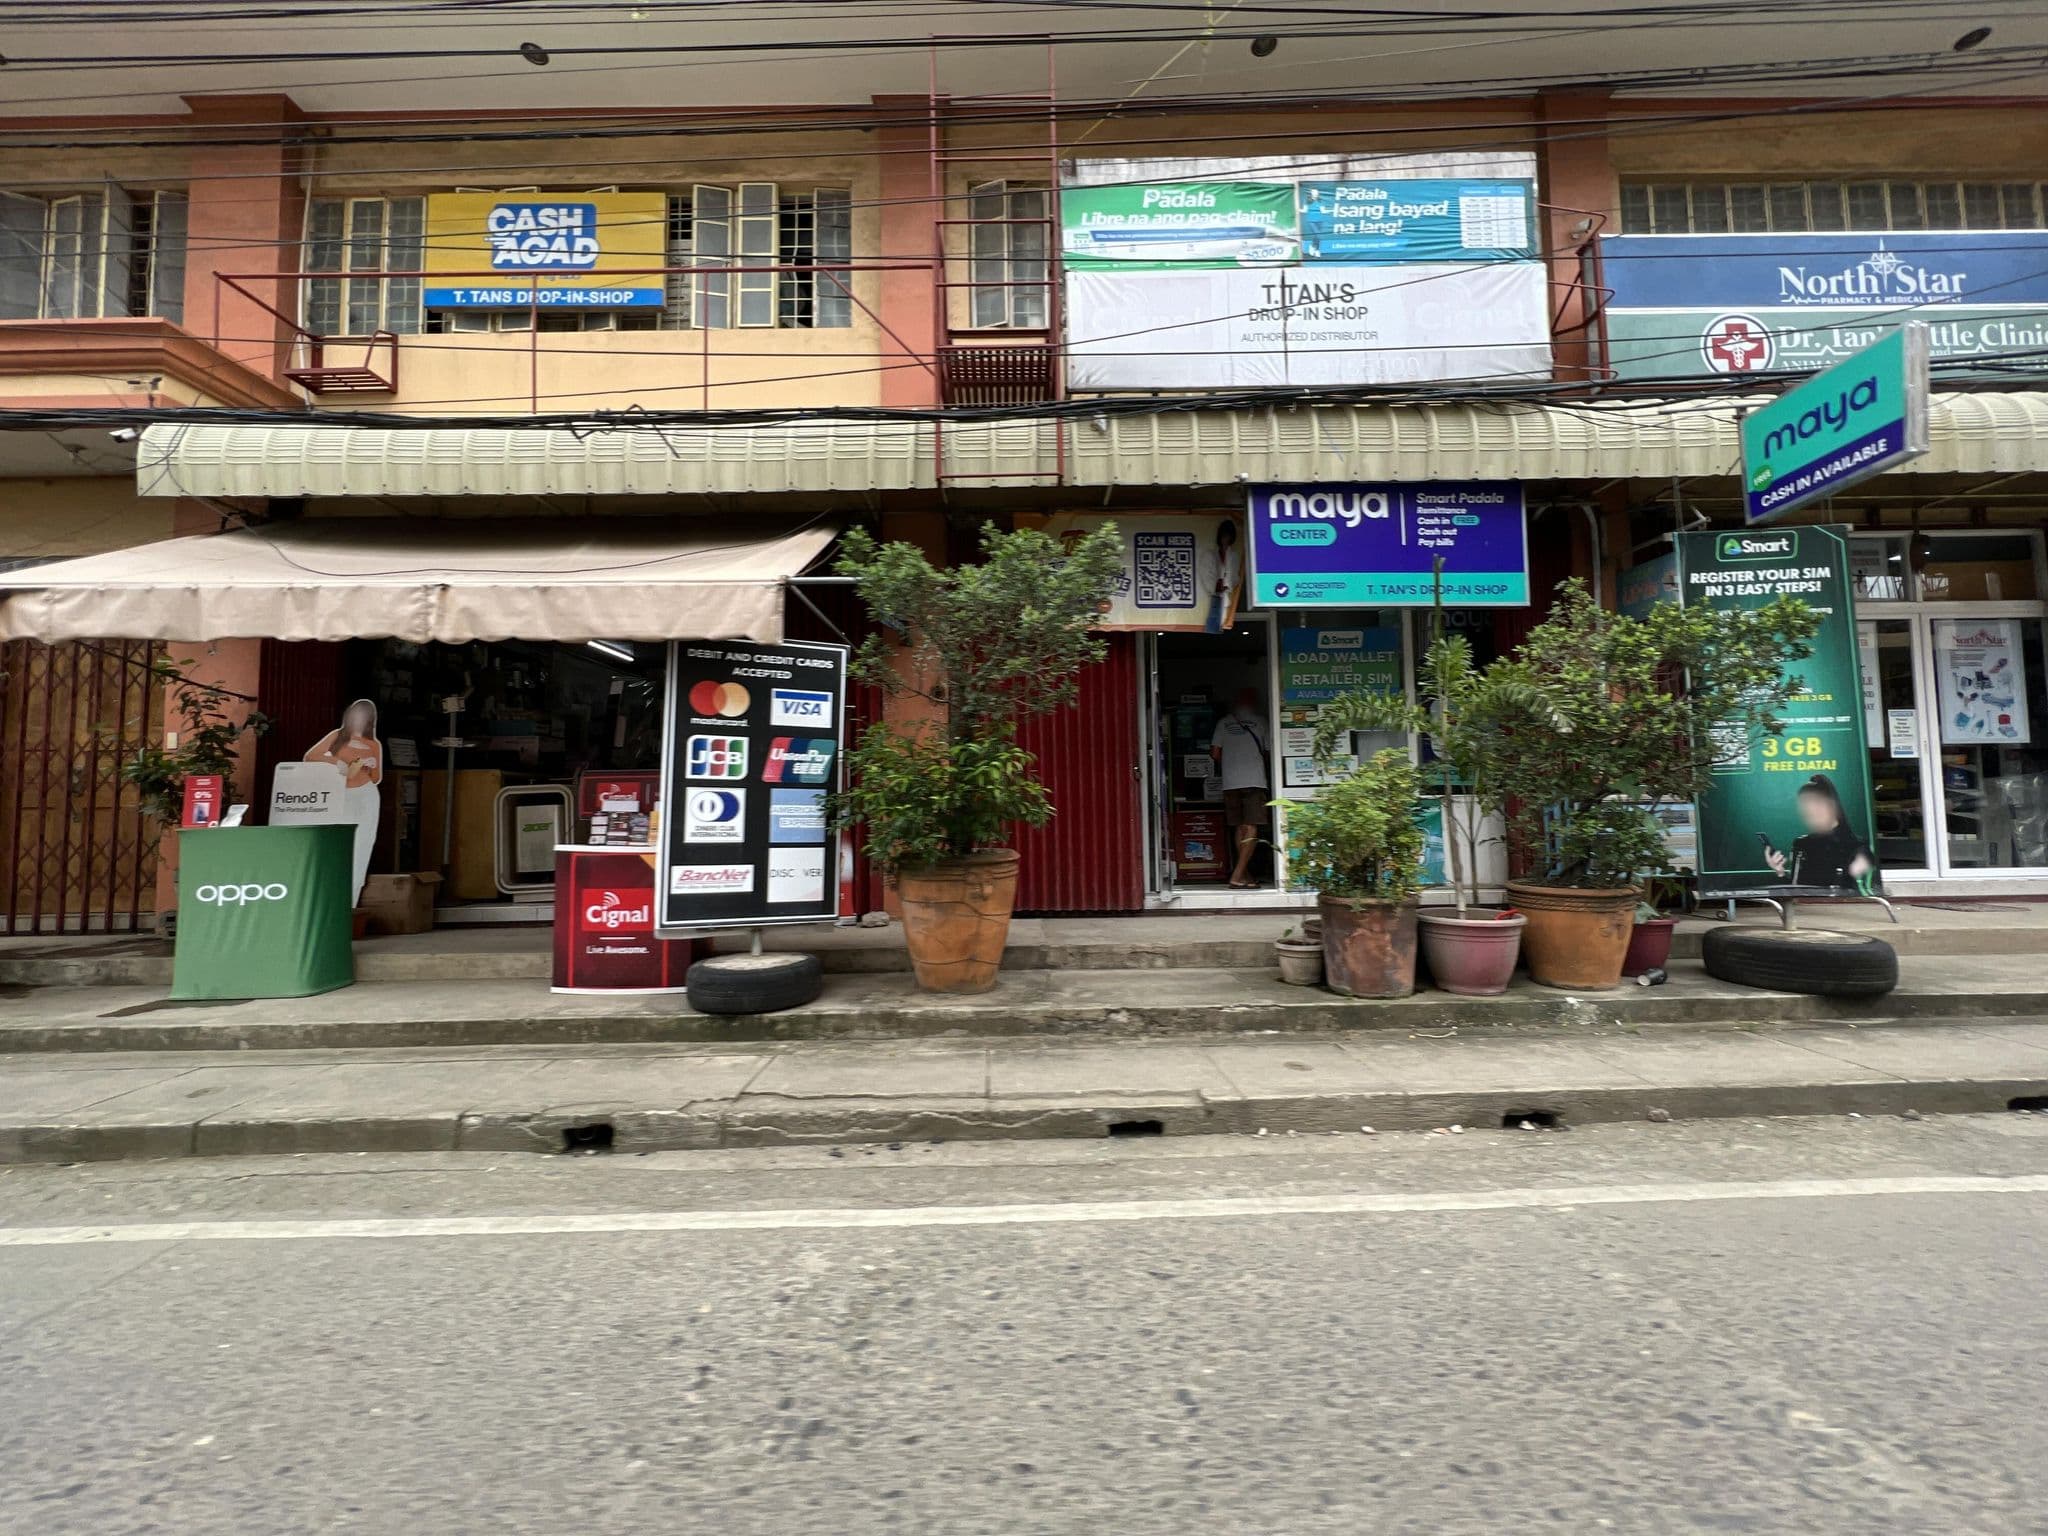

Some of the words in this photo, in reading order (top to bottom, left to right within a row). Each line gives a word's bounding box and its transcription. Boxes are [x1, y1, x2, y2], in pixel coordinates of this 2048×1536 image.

[1143, 188, 1216, 209] Padala
[1335, 187, 1388, 201] Padala
[1333, 202, 1384, 219] Isang
[1389, 200, 1449, 218] bayad
[487, 208, 583, 236] CASH
[1081, 211, 1123, 226] Libre
[1127, 214, 1149, 226] na
[1333, 222, 1355, 234] na
[1359, 219, 1403, 236] lang!
[490, 237, 600, 265] AGAD
[1778, 265, 1881, 297] North
[1895, 265, 1967, 294] Star
[453, 291, 466, 304] T.
[470, 290, 512, 304] TANS
[1249, 307, 1319, 322] DROP-IN
[1324, 306, 1368, 321] SHOP
[1241, 332, 1308, 342] AUTHORIZED
[1311, 331, 1378, 342] DISTRIBUTOR
[1778, 326, 1821, 348] Dr.
[1764, 376, 1877, 459] maya
[1761, 482, 1795, 507] CASH
[1797, 474, 1812, 491] IN
[1812, 438, 1888, 483] AVAILABLE
[1416, 492, 1457, 504] Smart
[1459, 492, 1504, 504] Padala
[1269, 492, 1389, 528] maya
[1416, 506, 1467, 514] Remittance
[1417, 517, 1440, 525] Cash
[1441, 516, 1450, 525] in
[1279, 529, 1328, 540] CENTER
[1417, 528, 1440, 536] Cash
[1441, 528, 1458, 536] out
[1137, 536, 1166, 546] SCAN
[1167, 536, 1193, 546] HERE
[1418, 538, 1435, 548] Pay
[1436, 538, 1455, 546] bills
[1741, 537, 1790, 553] Smart
[1690, 570, 1755, 584] REGISTER
[1756, 568, 1800, 580] YOUR
[1803, 567, 1831, 579] SIM
[1295, 582, 1347, 590] ACCREDITED
[1366, 585, 1377, 595] T.
[1381, 585, 1417, 595] TAN'S
[1475, 585, 1508, 595] SHOP
[1705, 585, 1722, 597] IN
[1724, 584, 1736, 596] 3
[1736, 583, 1773, 596] EASY
[1775, 581, 1822, 593] STEPS!
[1295, 591, 1324, 599] AGENT
[1330, 633, 1361, 646] Smart
[687, 649, 723, 660] DEBIT
[725, 651, 751, 662] AND
[752, 654, 795, 666] CREDIT
[795, 657, 835, 669] CARDS
[1288, 652, 1329, 664] LOAD
[1334, 651, 1395, 664] WALLET
[731, 667, 793, 679] ACCEPTED
[1331, 664, 1353, 673] and
[1292, 674, 1363, 686] RETAILER
[1367, 673, 1393, 684] SIM
[782, 701, 822, 716] VISA
[1762, 739, 1779, 757] 3
[1784, 737, 1822, 756] GB
[690, 750, 742, 765] JCB
[770, 748, 832, 767] UnionPay
[1763, 761, 1794, 772] FREE
[1797, 760, 1837, 771] DATA!
[275, 791, 318, 804] Reno8
[320, 791, 331, 803] T
[679, 869, 750, 882] BancNet
[196, 883, 288, 907] oppo
[586, 904, 649, 928] Cignal
[586, 945, 604, 954] Live
[605, 945, 650, 954] Awesome.
